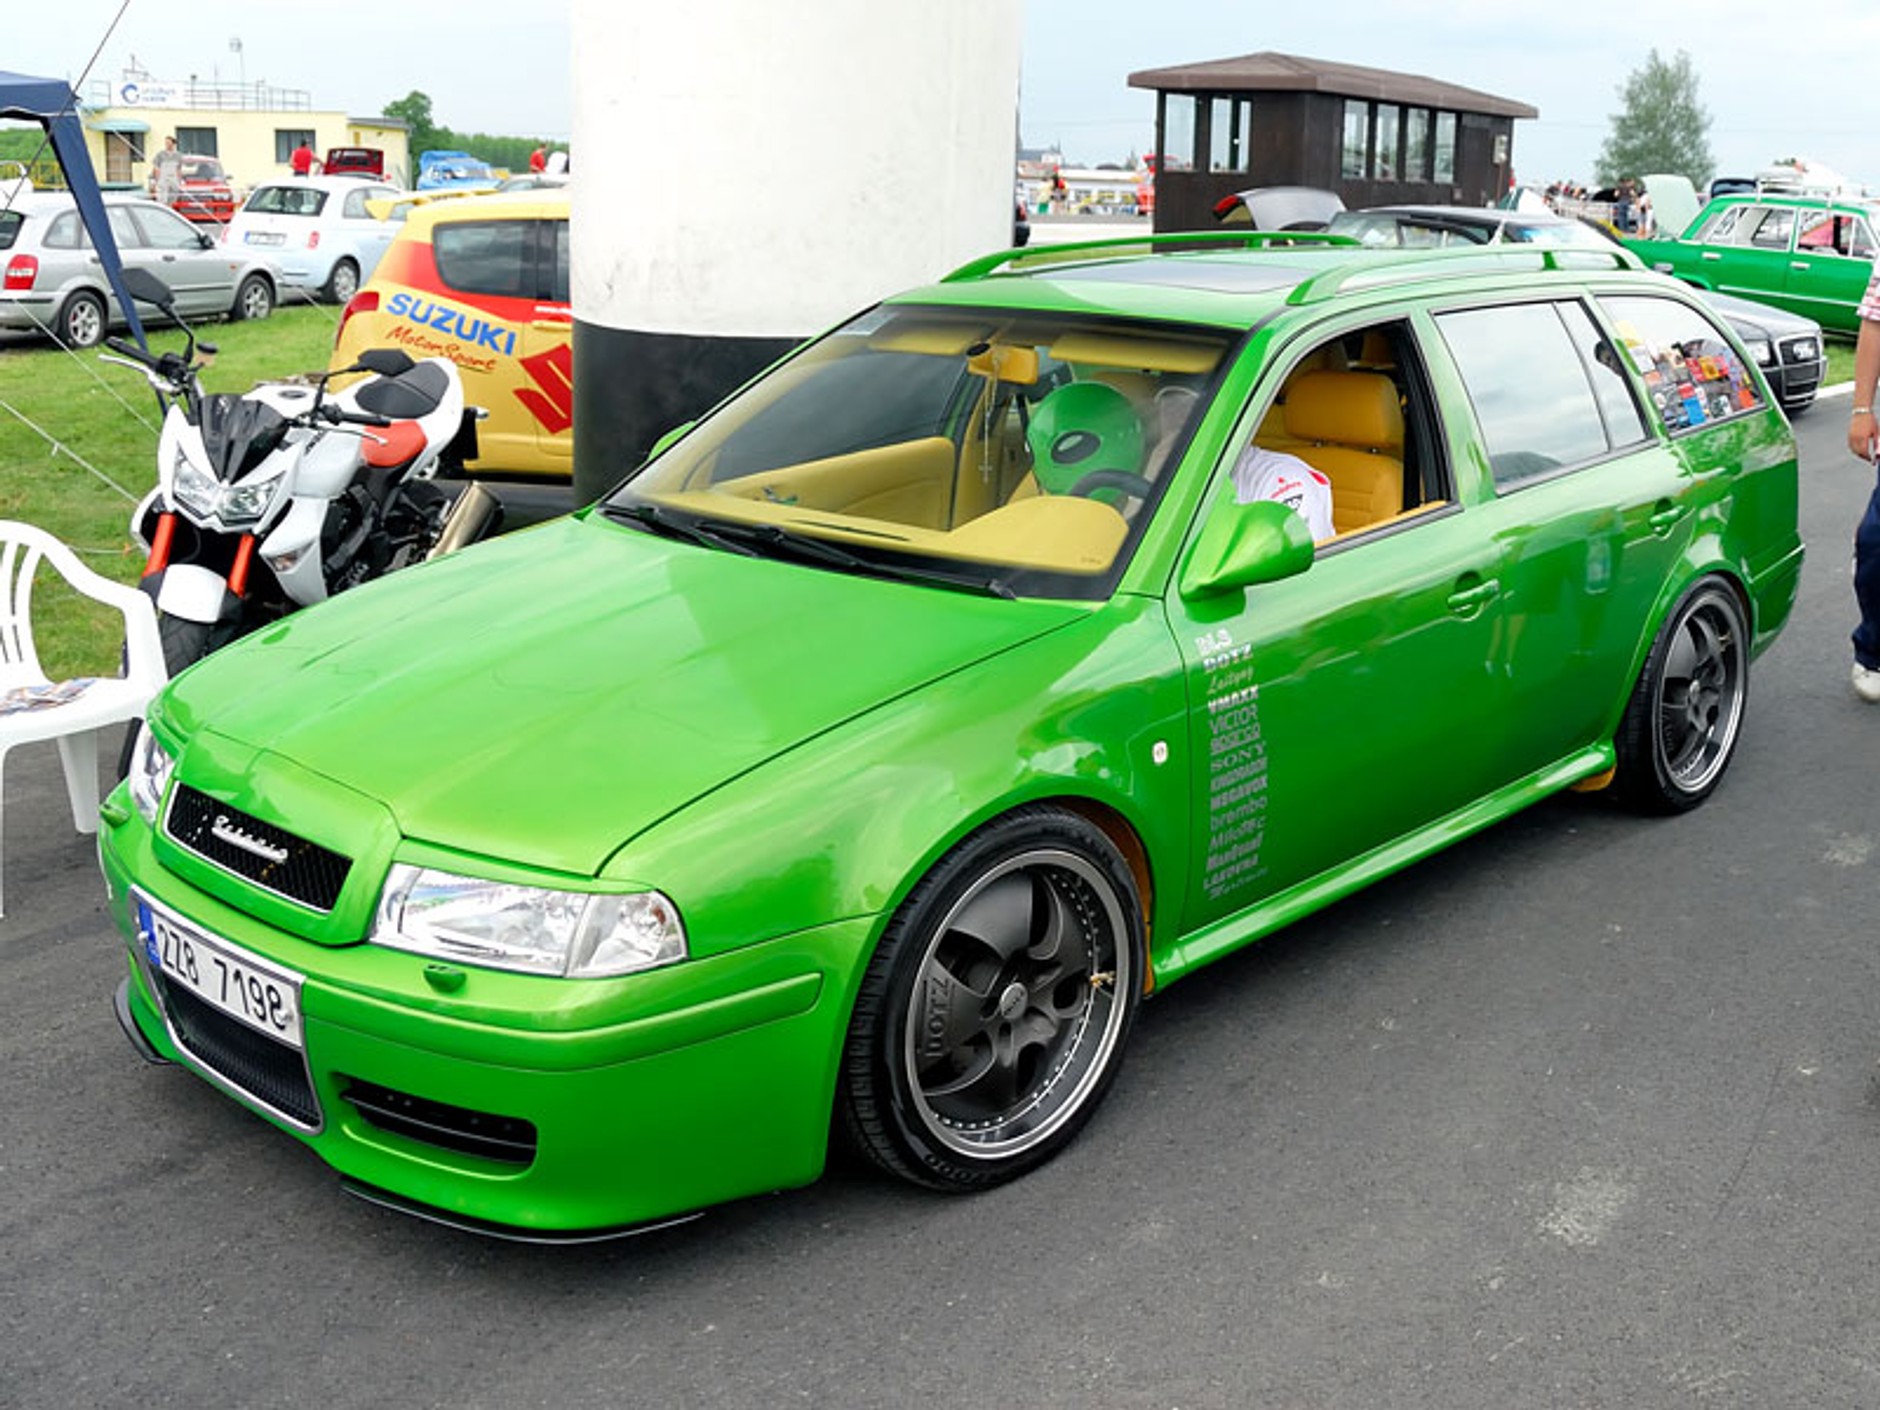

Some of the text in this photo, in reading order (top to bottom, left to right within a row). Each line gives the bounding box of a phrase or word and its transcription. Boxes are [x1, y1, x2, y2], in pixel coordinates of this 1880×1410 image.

[386, 293, 516, 356] SUZUKI
[1208, 704, 1259, 735] VICTOR
[1210, 741, 1266, 772] SONY
